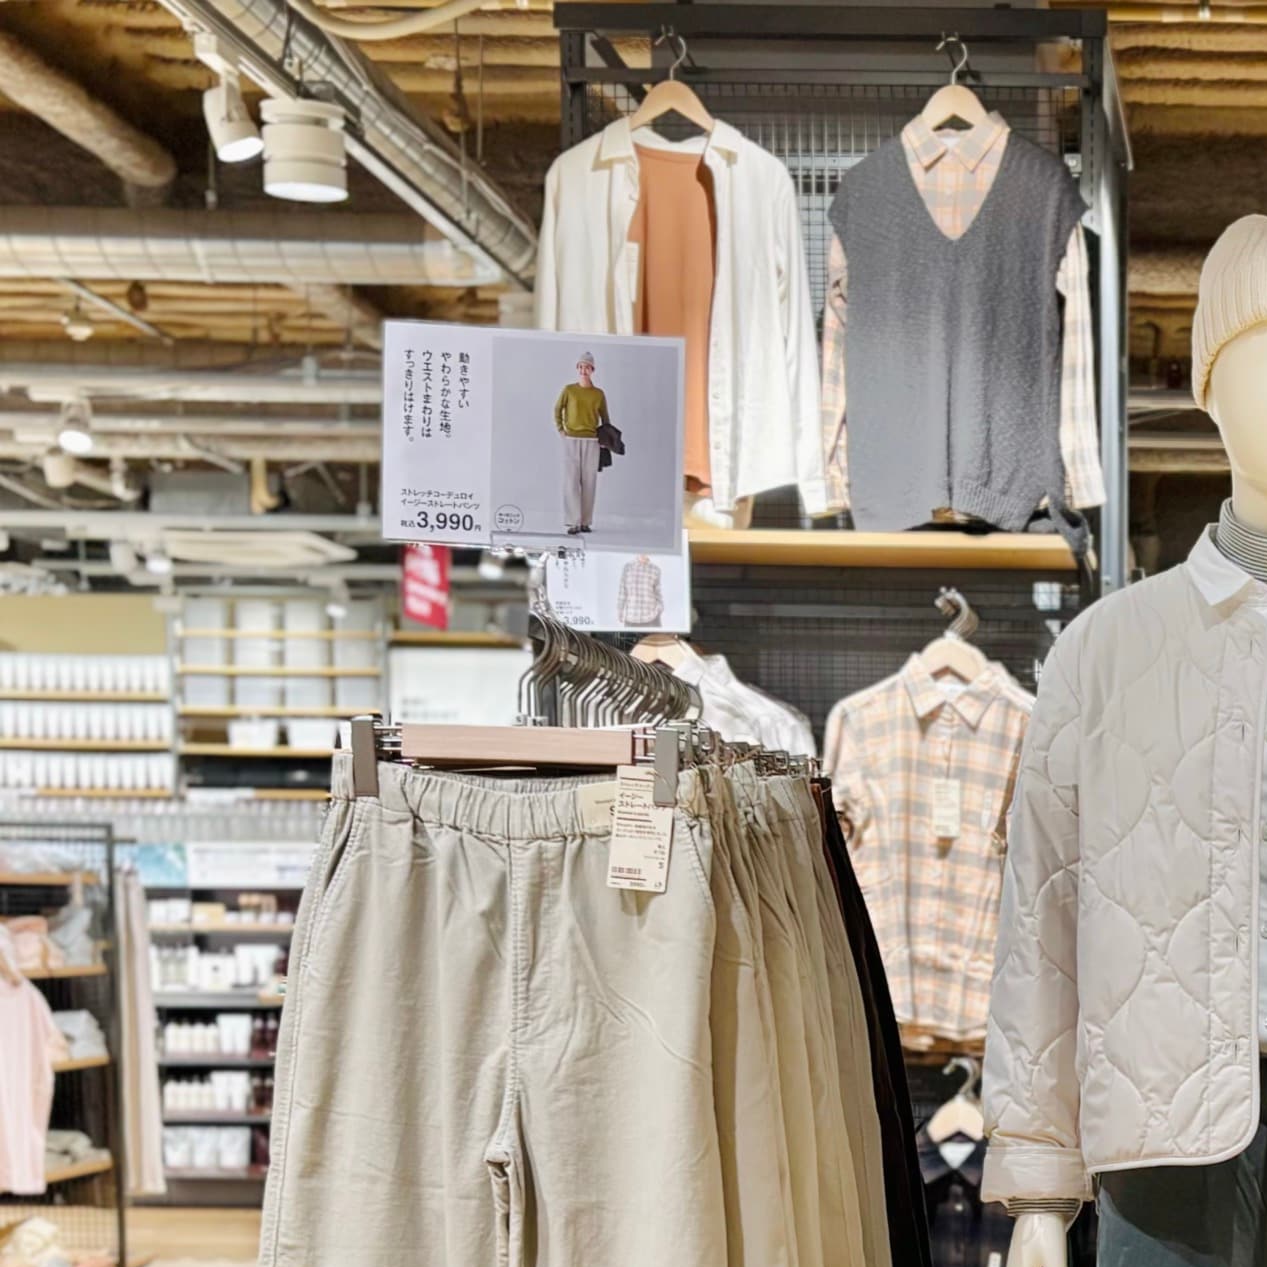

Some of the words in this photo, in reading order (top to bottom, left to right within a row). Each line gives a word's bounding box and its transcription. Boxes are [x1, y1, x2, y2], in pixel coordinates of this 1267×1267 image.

[421, 349, 433, 438] ウエストまわりは
[458, 351, 470, 409] 動きやすい
[400, 488, 474, 501] ストレッチコーデュロイ
[400, 498, 480, 510] イージーストレートパンツ
